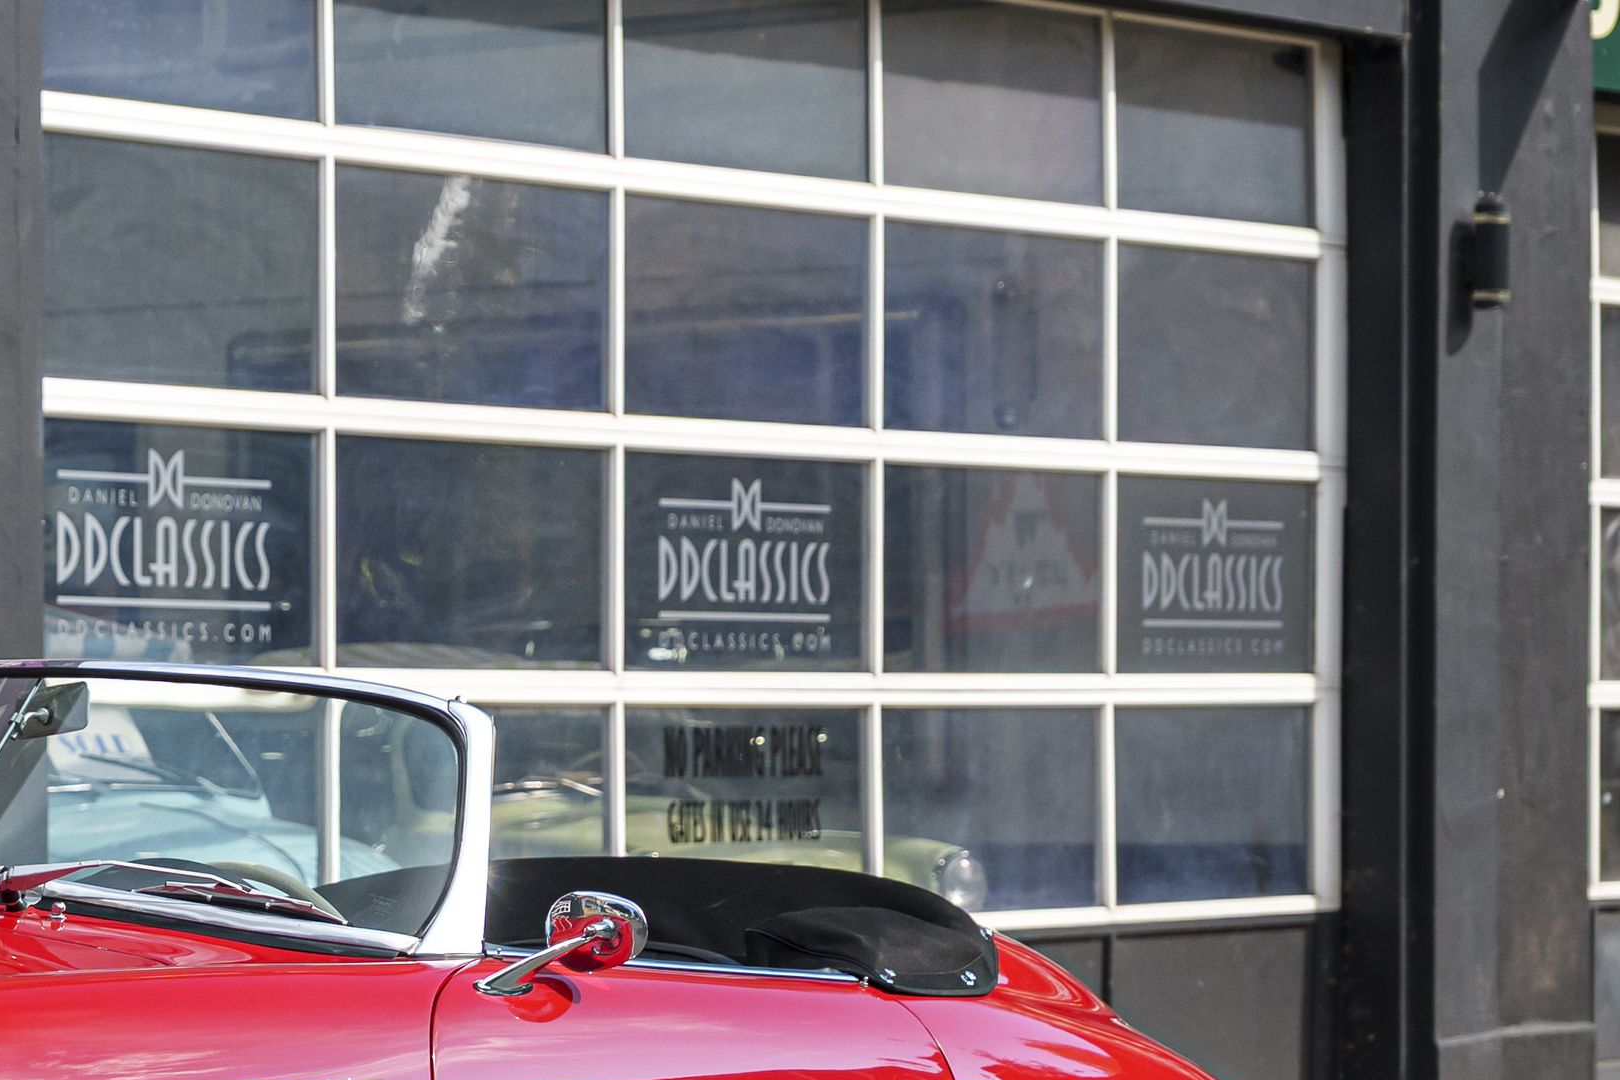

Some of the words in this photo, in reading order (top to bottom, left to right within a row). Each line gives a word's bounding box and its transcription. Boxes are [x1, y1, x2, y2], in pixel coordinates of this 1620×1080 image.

[67, 486, 139, 507] DANIEL
[56, 510, 271, 591] DDCLASSICS
[657, 534, 831, 605] DDCLASSICS
[1142, 550, 1284, 613] DDCLASSICS
